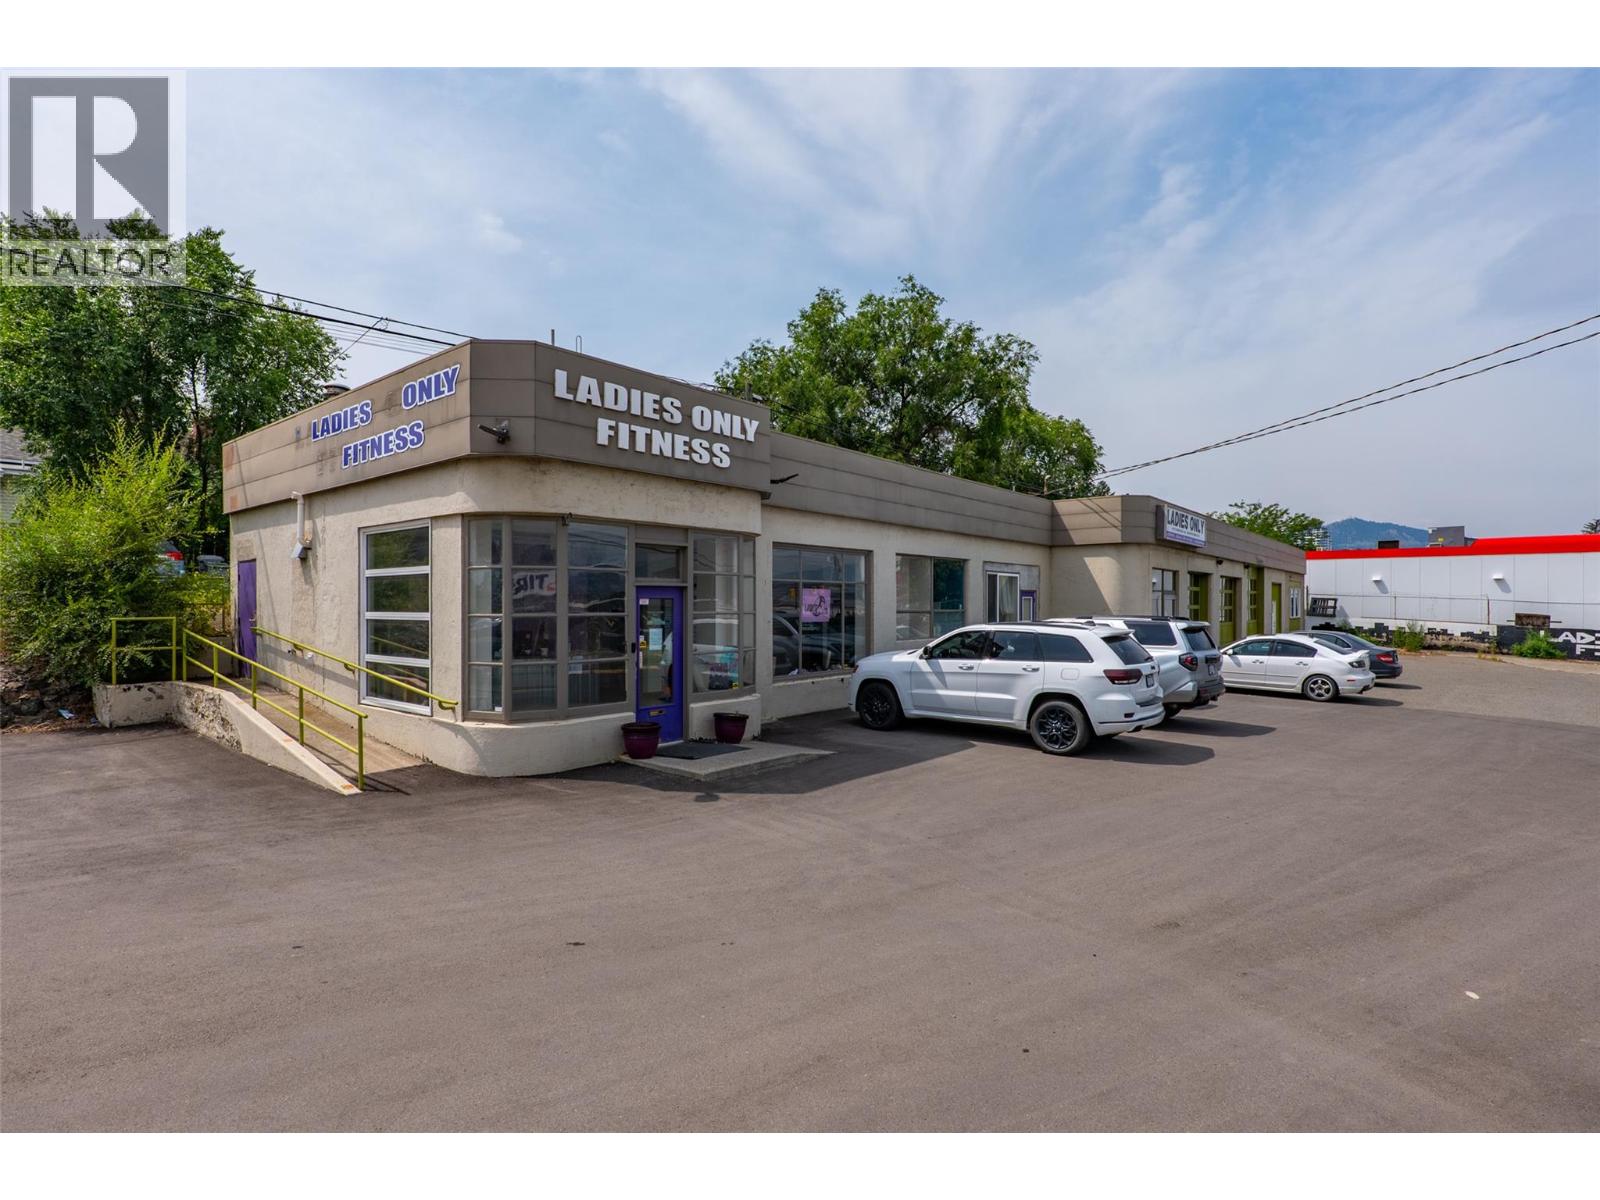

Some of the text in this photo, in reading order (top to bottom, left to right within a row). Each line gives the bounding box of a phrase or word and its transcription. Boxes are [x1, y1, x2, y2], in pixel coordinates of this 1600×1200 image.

[311, 364, 461, 442] LADIES ONLY
[554, 369, 759, 442] LADIES ONLY
[342, 420, 425, 469] FITNESS
[597, 417, 731, 468] FITNESS
[1167, 508, 1189, 530] LADIES
[1190, 516, 1205, 535] ONLY
